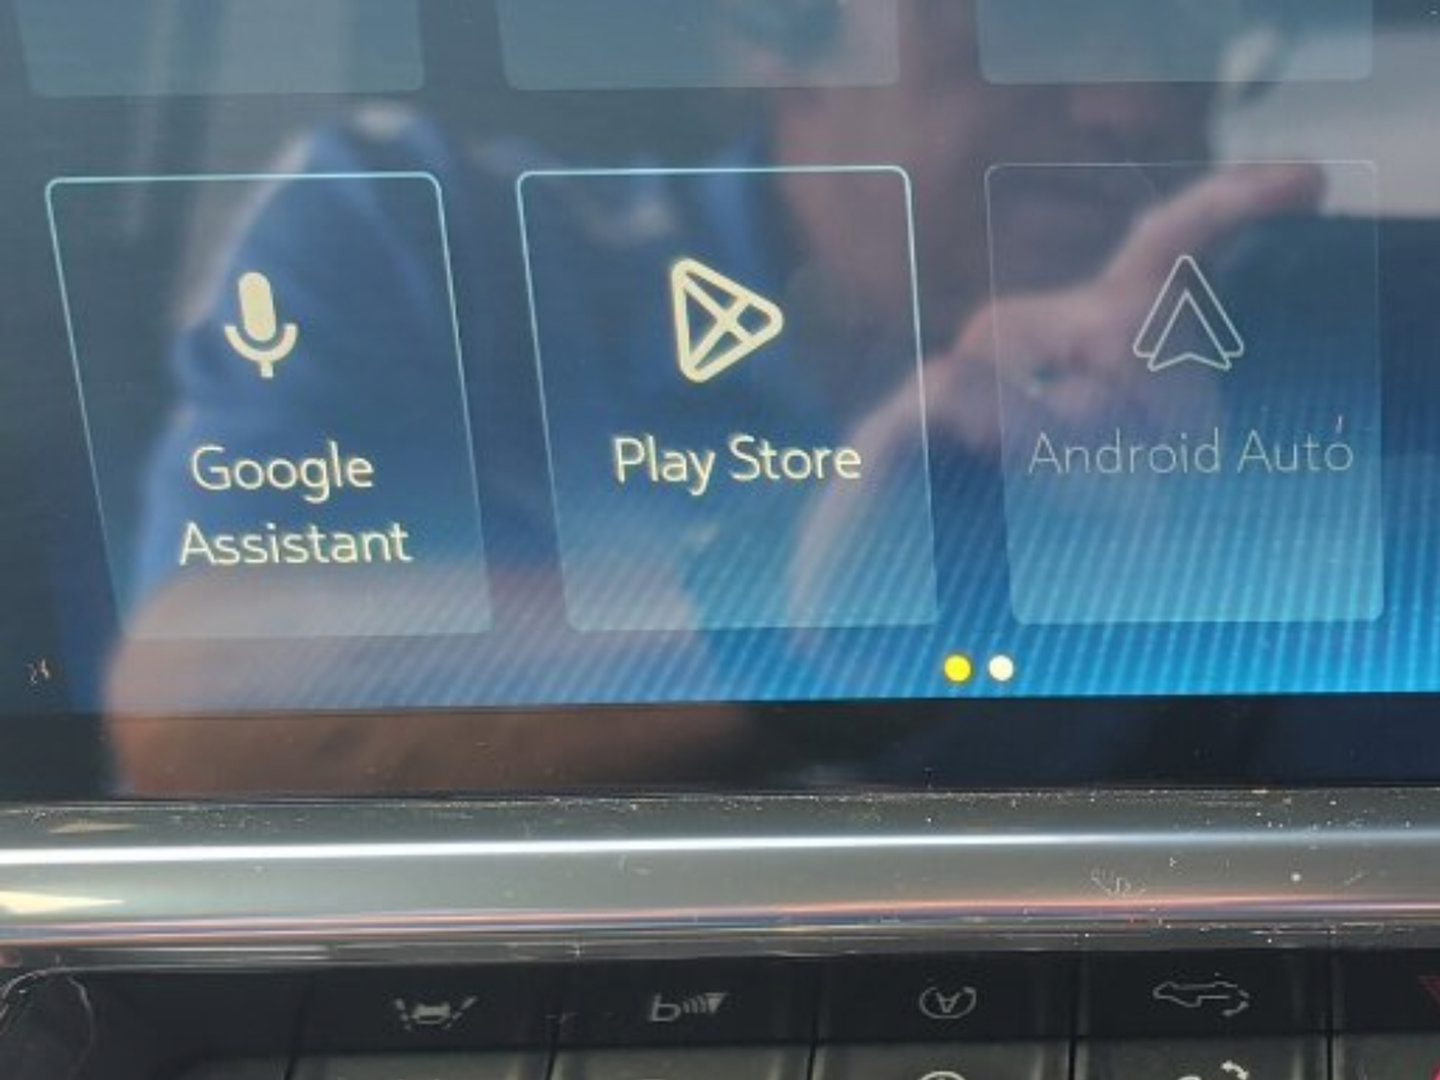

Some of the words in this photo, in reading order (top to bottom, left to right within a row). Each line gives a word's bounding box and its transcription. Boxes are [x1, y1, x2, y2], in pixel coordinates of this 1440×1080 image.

[190, 440, 374, 503] Google
[613, 434, 716, 496] Play
[728, 434, 862, 483] Store
[1027, 429, 1222, 476] Android
[1237, 430, 1354, 474] Auto
[178, 521, 414, 566] Assistant
